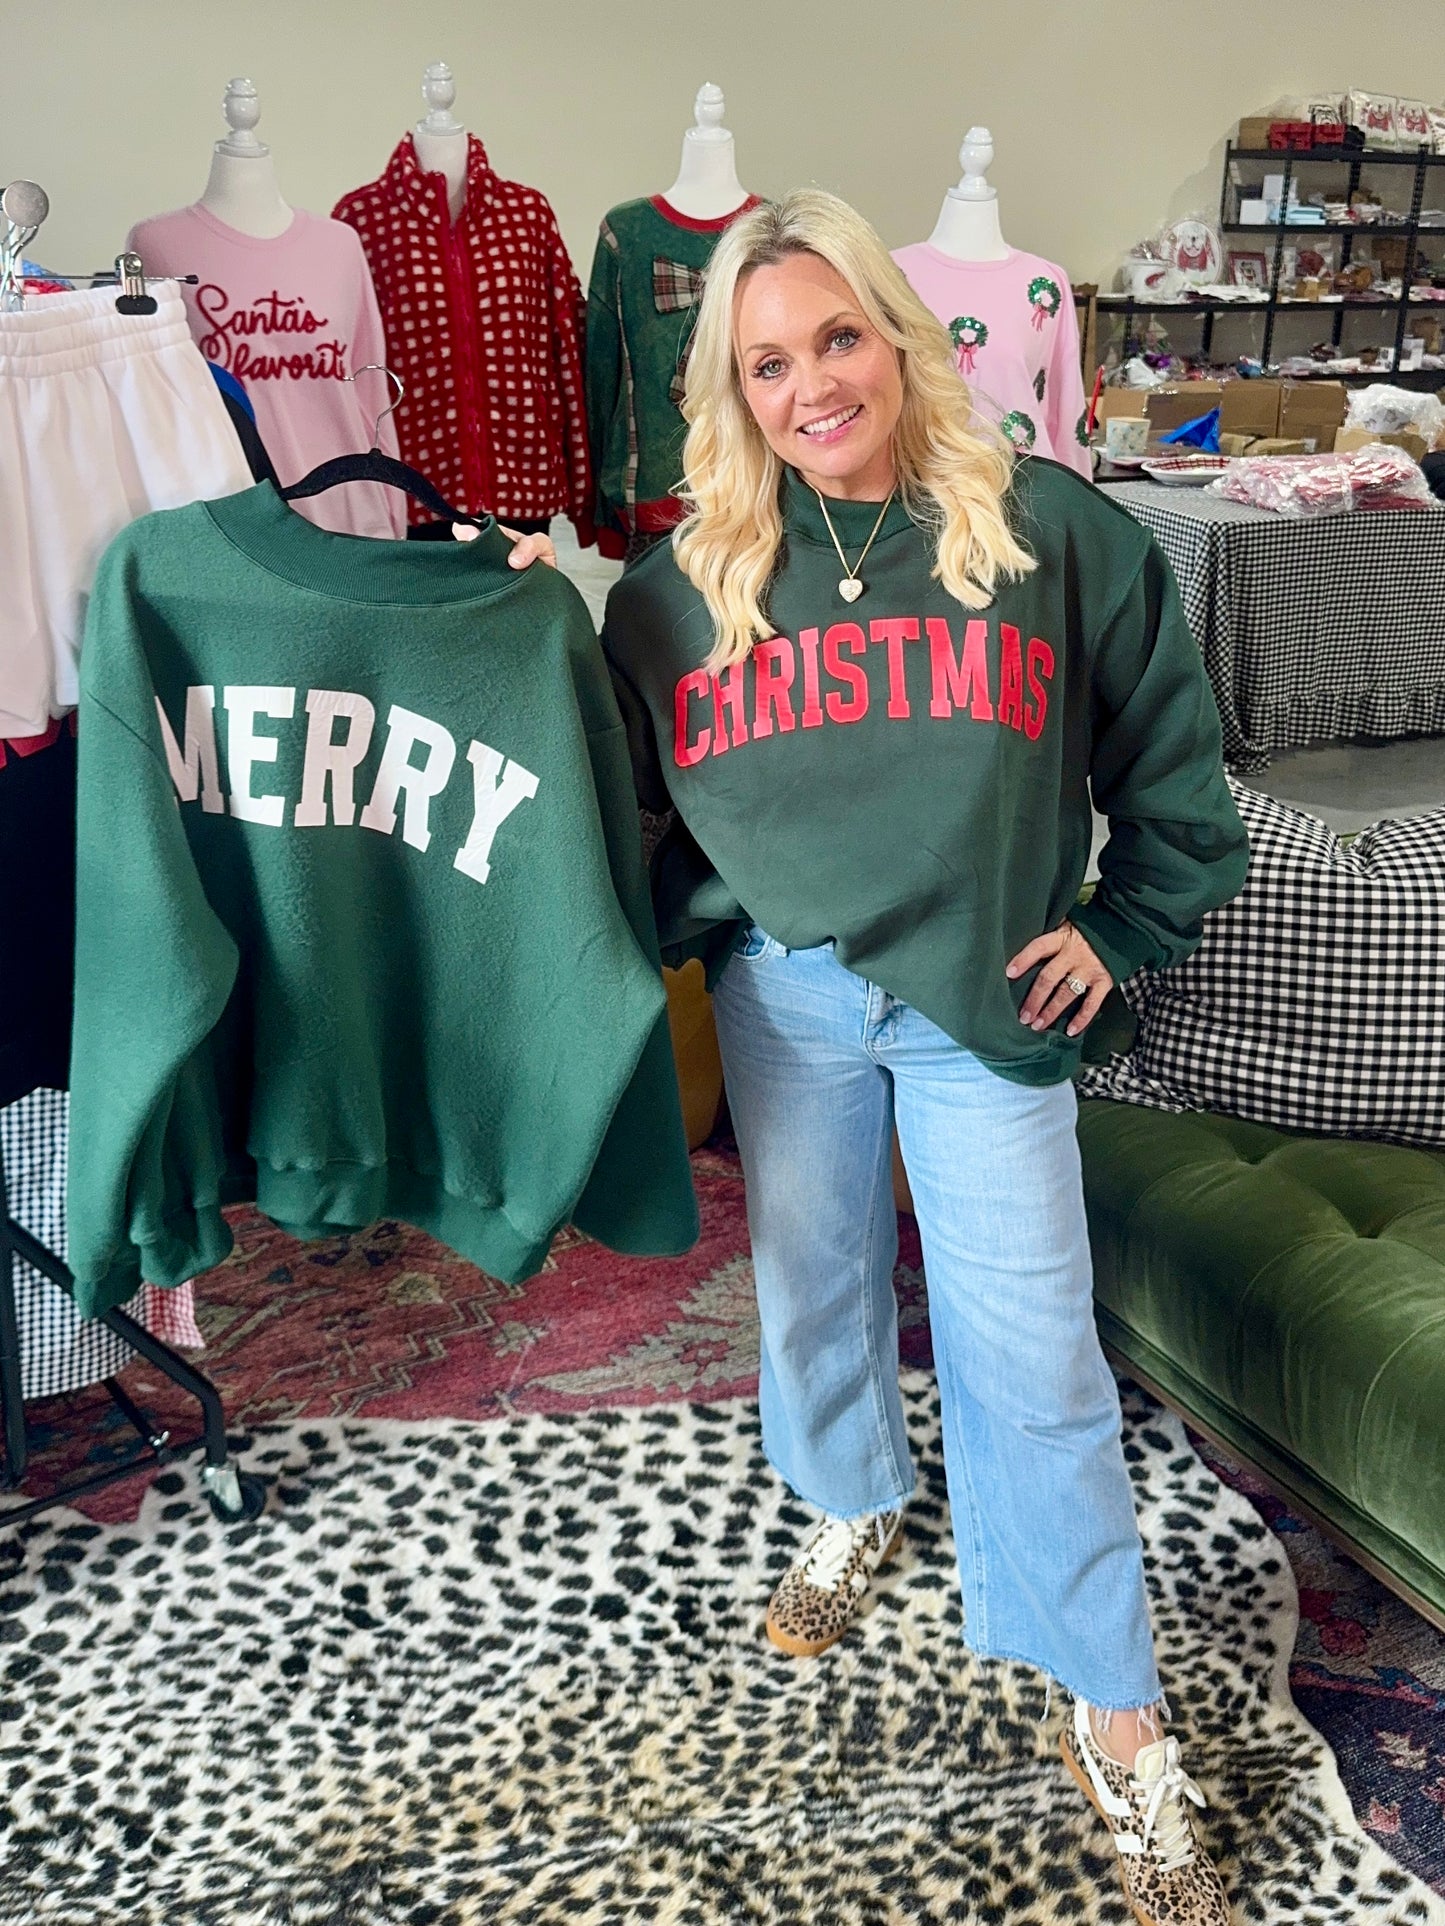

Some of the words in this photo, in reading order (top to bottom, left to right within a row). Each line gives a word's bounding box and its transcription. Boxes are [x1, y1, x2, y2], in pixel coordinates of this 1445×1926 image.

[196, 284, 329, 370] Santa's
[674, 618, 1055, 768] CHRISTMAS
[154, 685, 540, 885] MERRY
